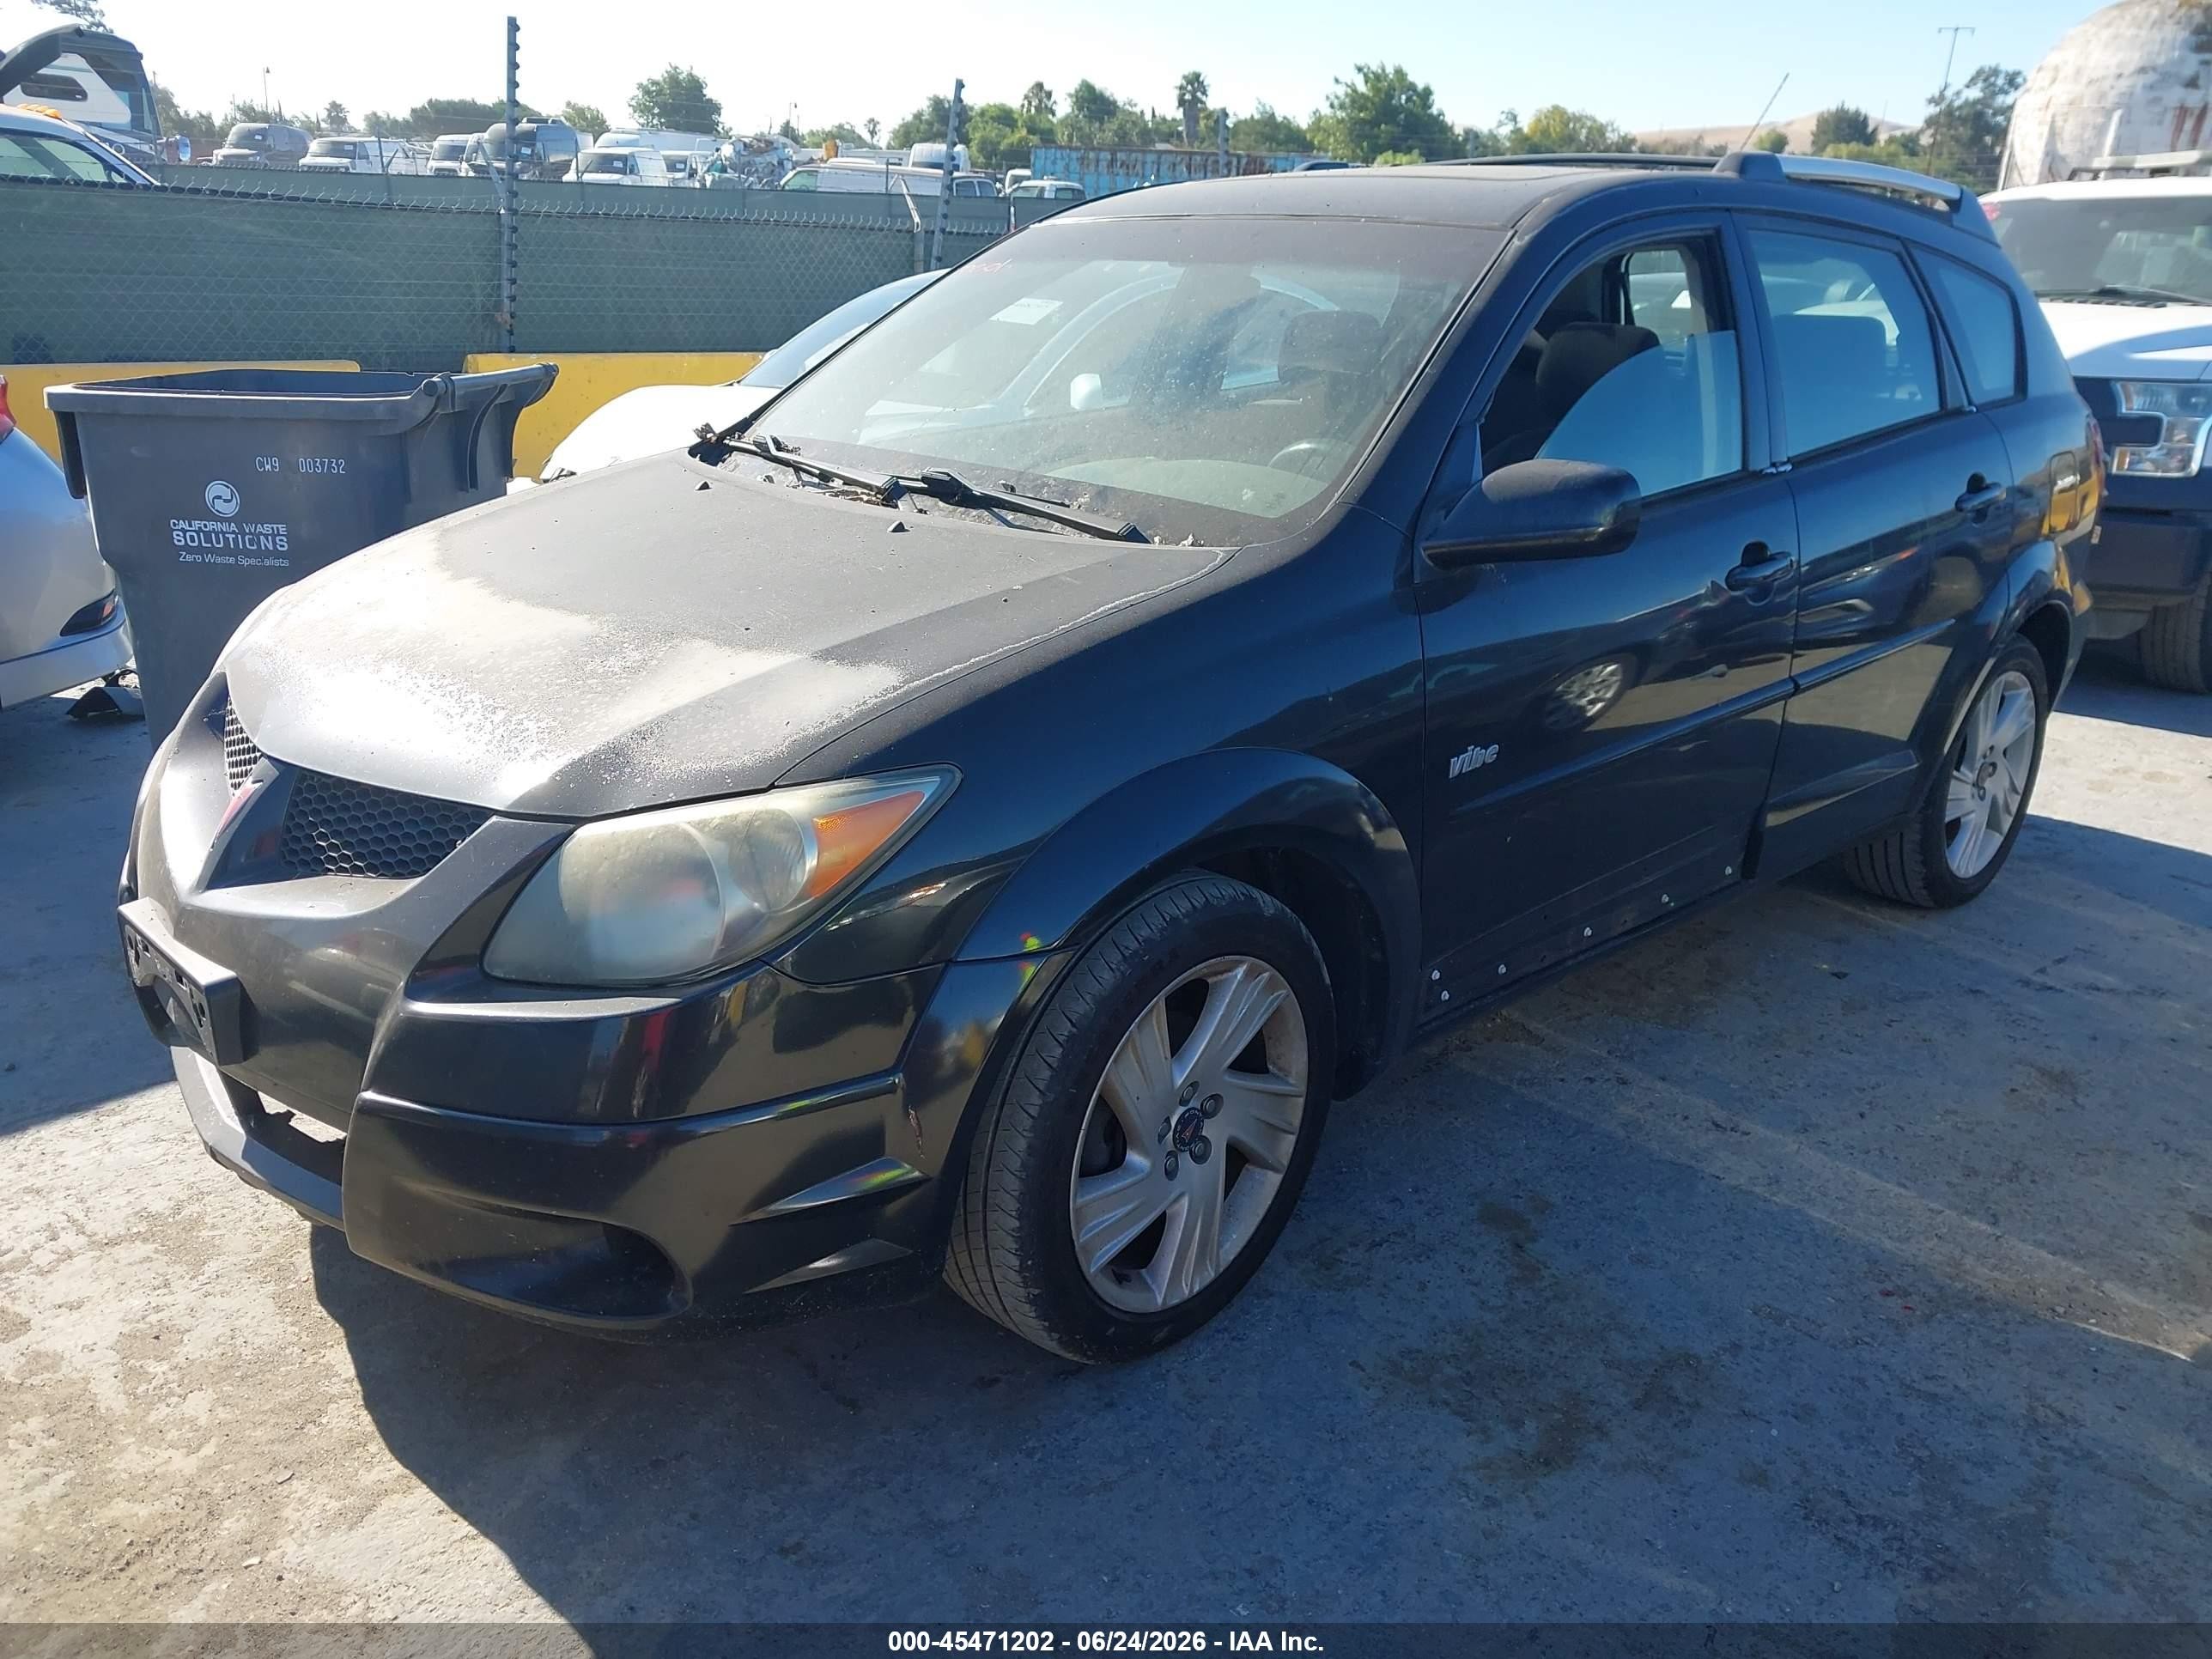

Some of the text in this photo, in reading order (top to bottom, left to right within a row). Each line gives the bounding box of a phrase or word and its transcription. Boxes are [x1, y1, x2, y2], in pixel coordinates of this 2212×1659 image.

[256, 457, 346, 474] CW9 003732
[170, 520, 287, 535] CALIFORNIA WASTE
[173, 531, 289, 551] SOLUTIONS
[179, 552, 289, 568] Zero Waste Specialists
